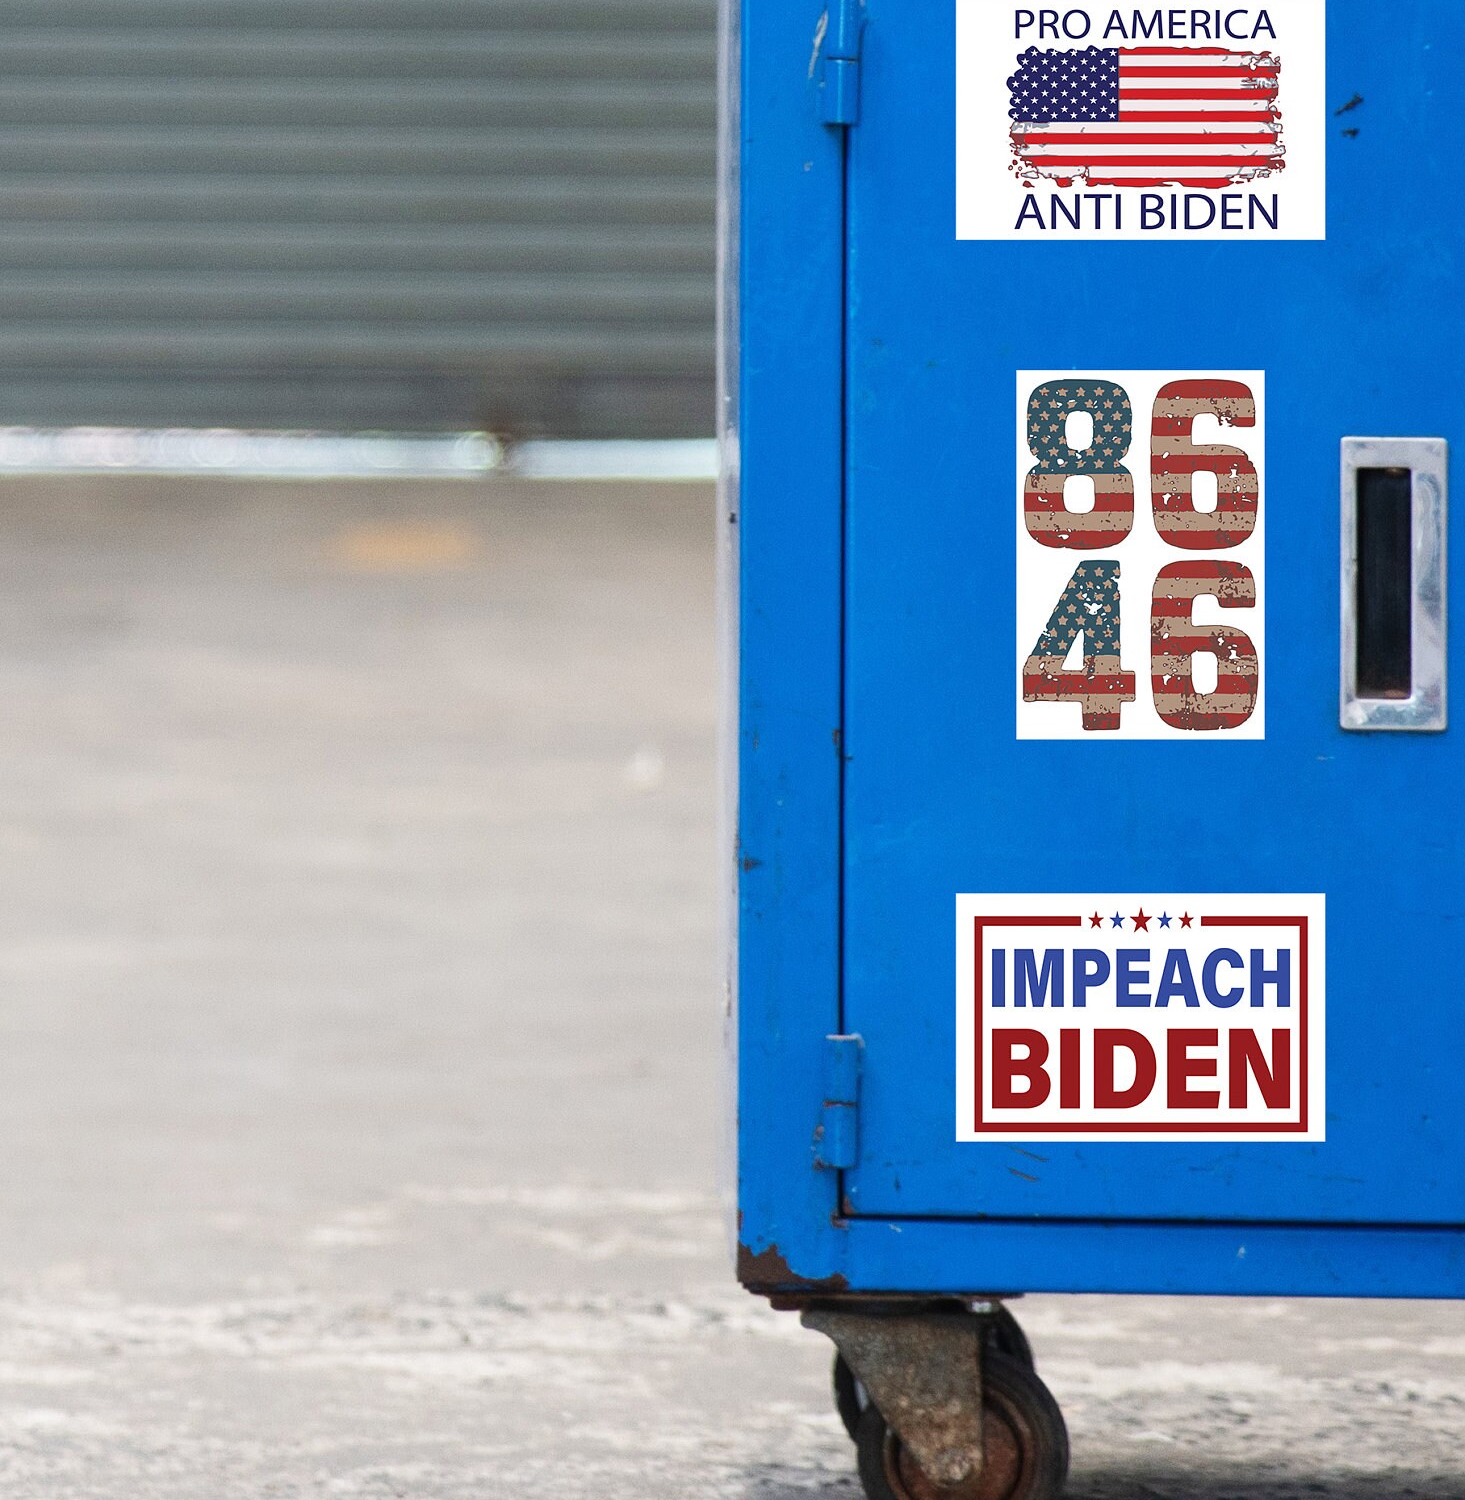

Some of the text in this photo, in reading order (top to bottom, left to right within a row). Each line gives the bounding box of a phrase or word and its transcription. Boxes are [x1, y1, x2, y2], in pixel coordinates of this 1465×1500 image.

[1014, 9, 1277, 40] PRO AMERICA
[1014, 193, 1279, 230] ANTI BIDEN
[1024, 379, 1259, 550] 86
[1022, 560, 1259, 731] 46
[991, 947, 1291, 1009] IMPEACH
[991, 1028, 1291, 1109] BIDEN
